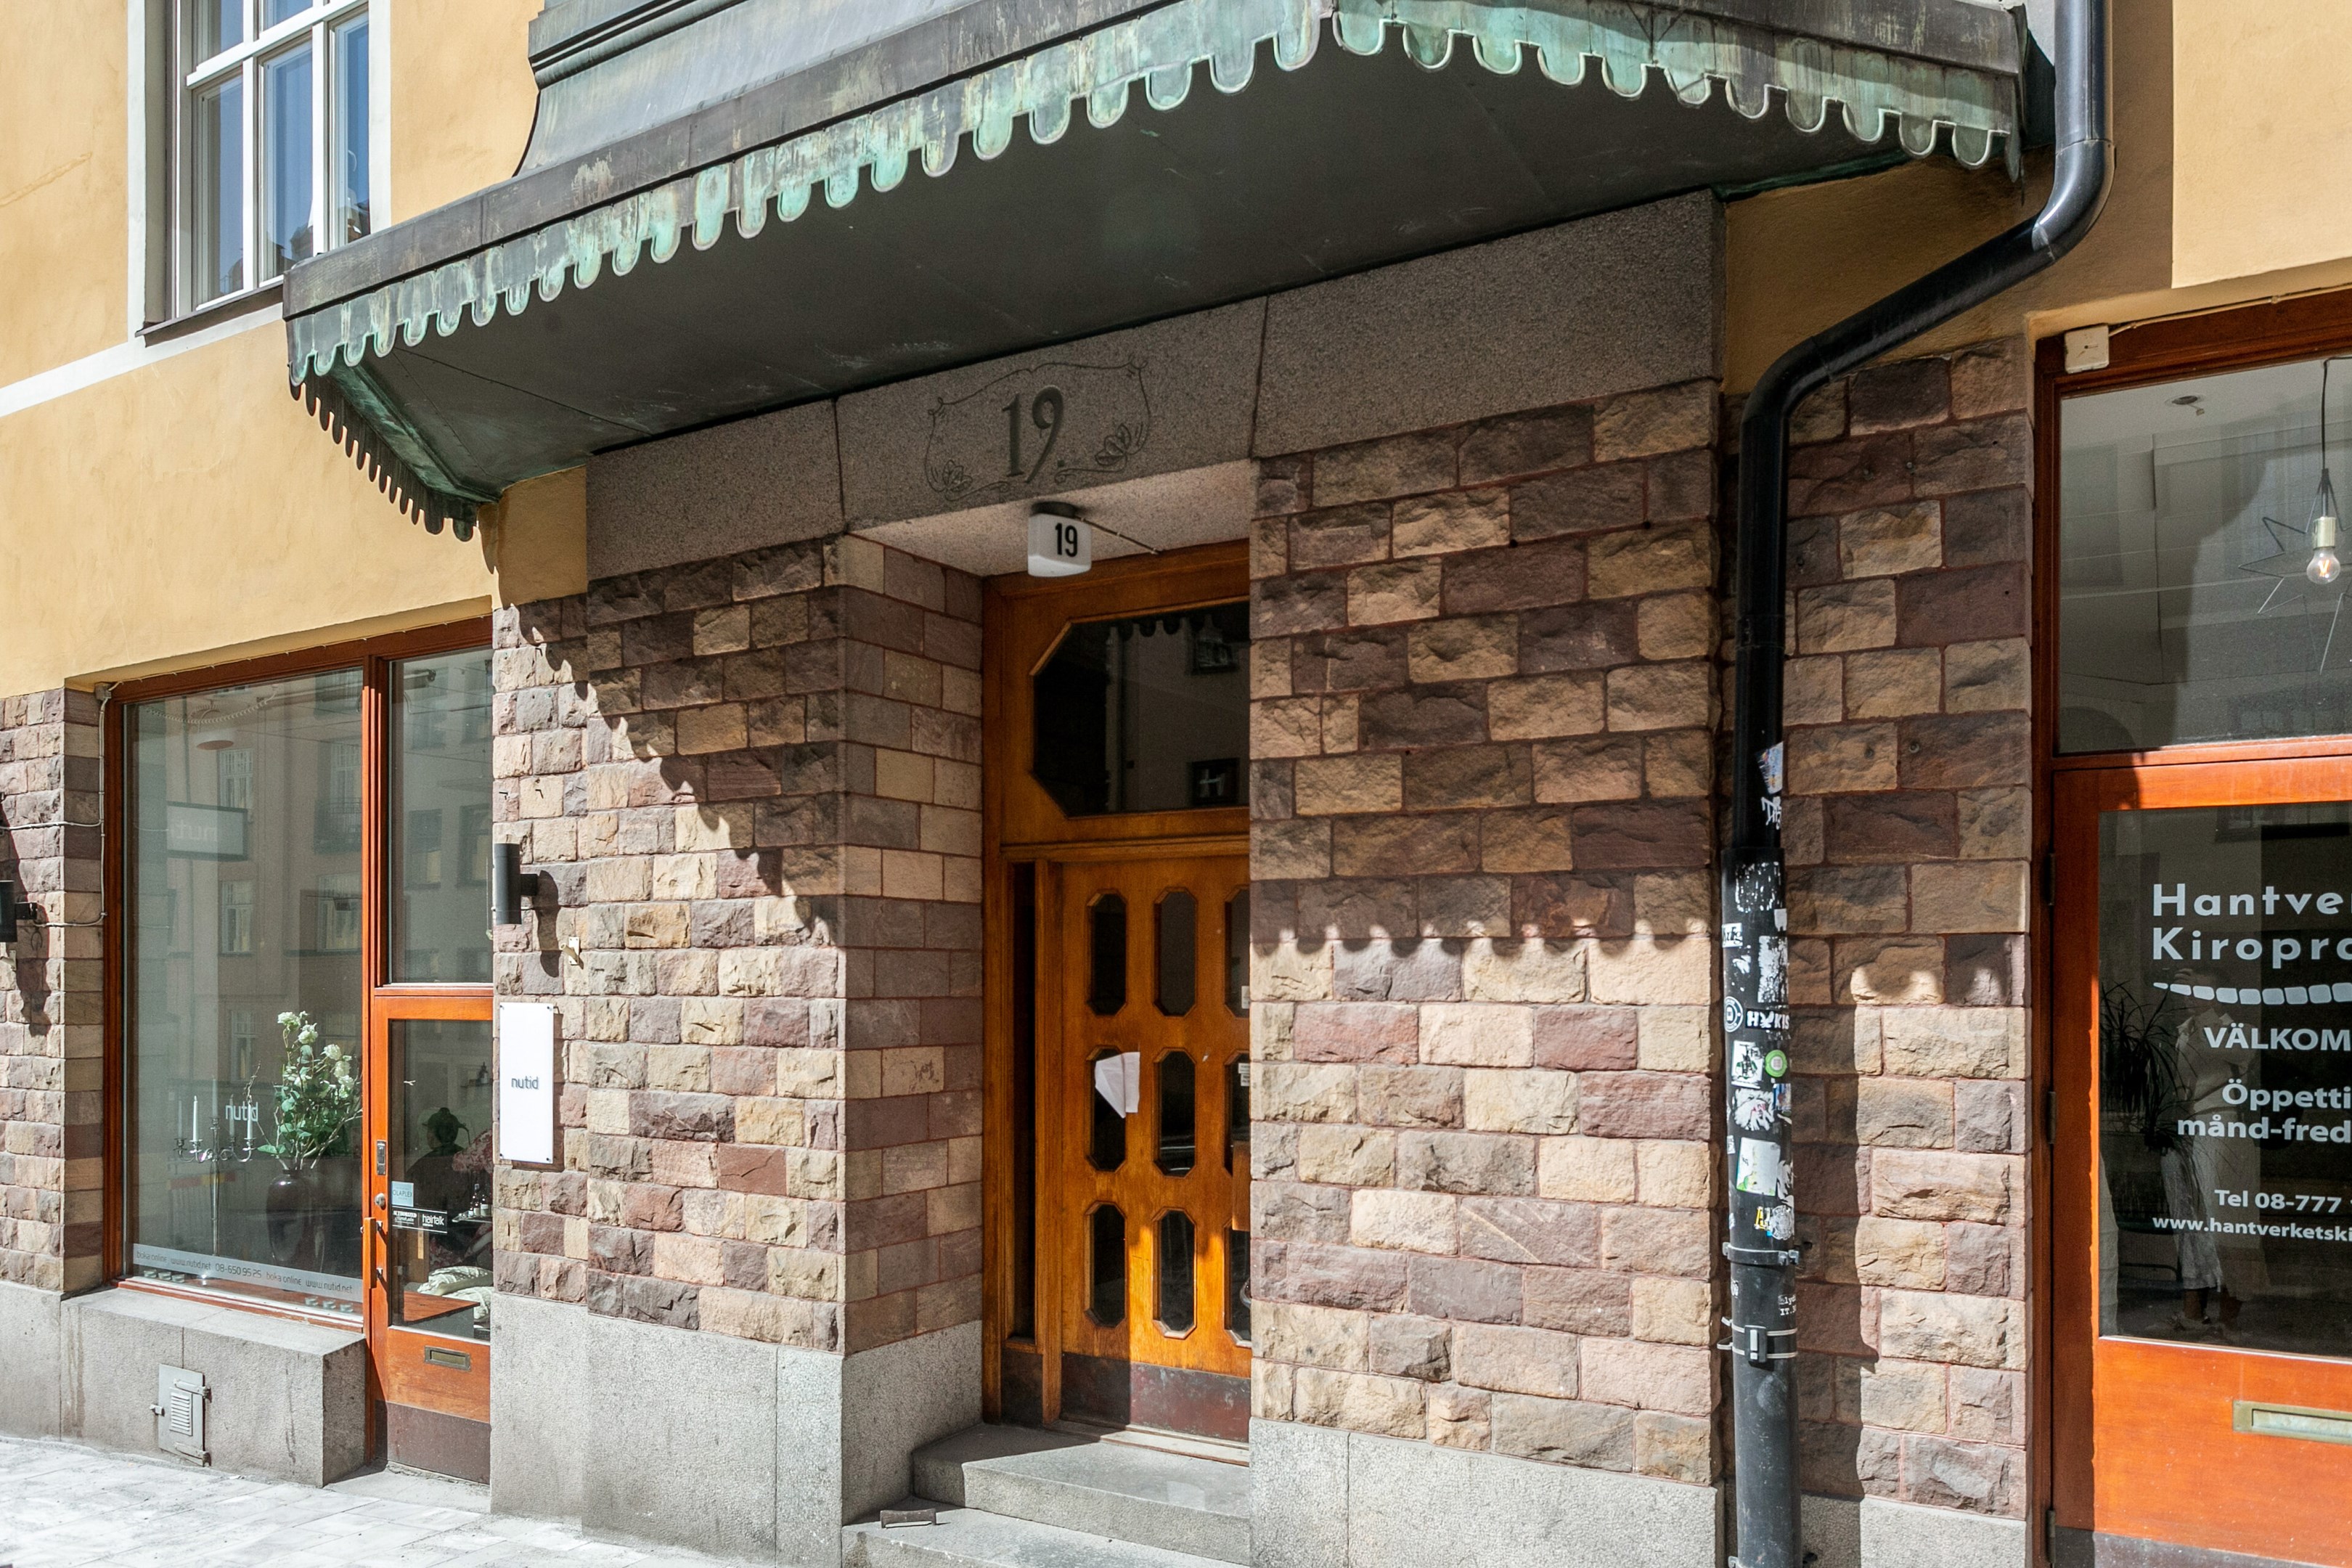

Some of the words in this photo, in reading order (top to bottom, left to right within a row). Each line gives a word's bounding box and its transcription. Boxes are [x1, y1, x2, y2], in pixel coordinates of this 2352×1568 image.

[1055, 523, 1078, 557] 19
[2153, 883, 2352, 916] Hantve
[2203, 1022, 2351, 1051] VÄLKOM
[511, 1076, 539, 1090] nutid
[2222, 1078, 2351, 1111] Öppetti
[225, 1101, 258, 1122] nutid
[2178, 1114, 2351, 1143] månd-fred
[2215, 1189, 2248, 1207] Tel
[2255, 1193, 2342, 1213] 08-777
[2152, 1217, 2352, 1242] www.hantverketski
[216, 1263, 242, 1275] 08-650
